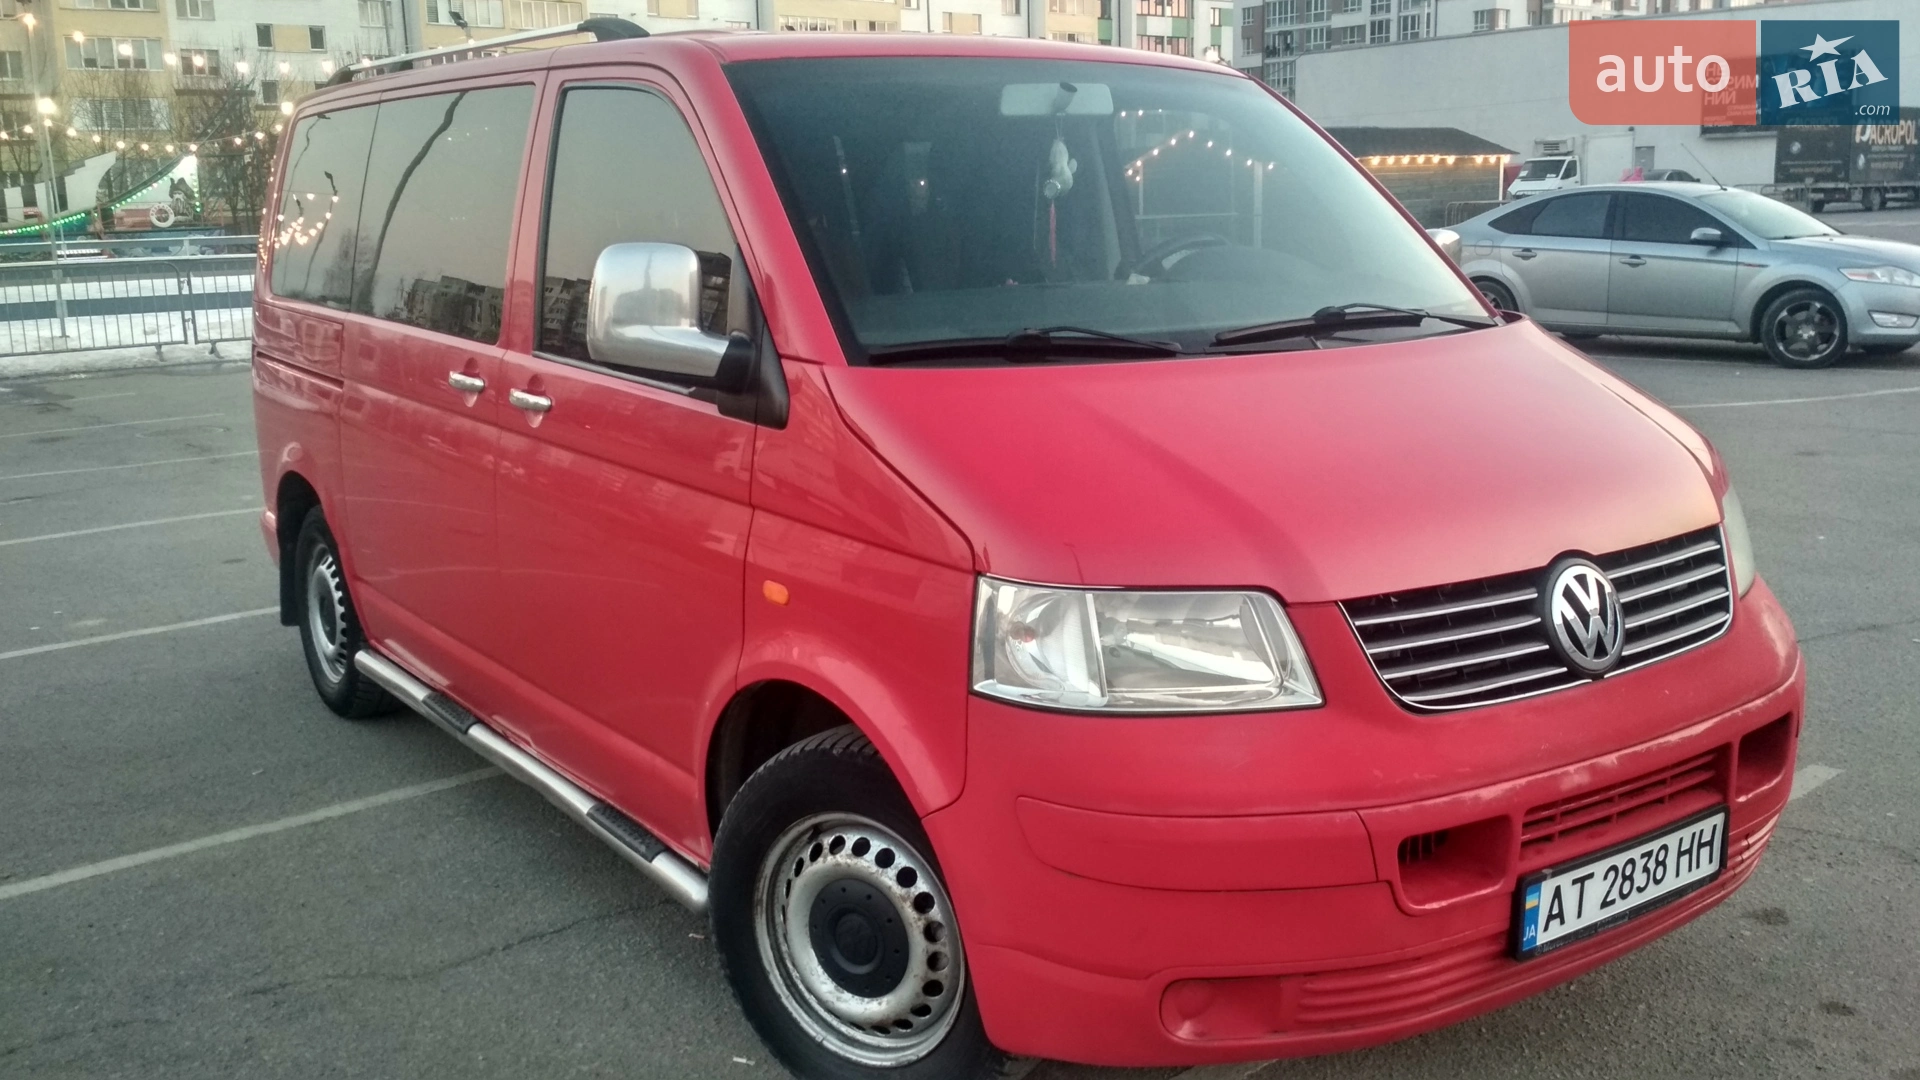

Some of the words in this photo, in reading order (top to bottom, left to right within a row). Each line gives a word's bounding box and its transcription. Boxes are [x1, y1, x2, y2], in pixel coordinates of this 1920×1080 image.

[1868, 119, 1918, 145] ACROPOL
[1543, 872, 1595, 932] AT
[1600, 843, 1669, 909] 2838
[1675, 823, 1718, 878] HH
